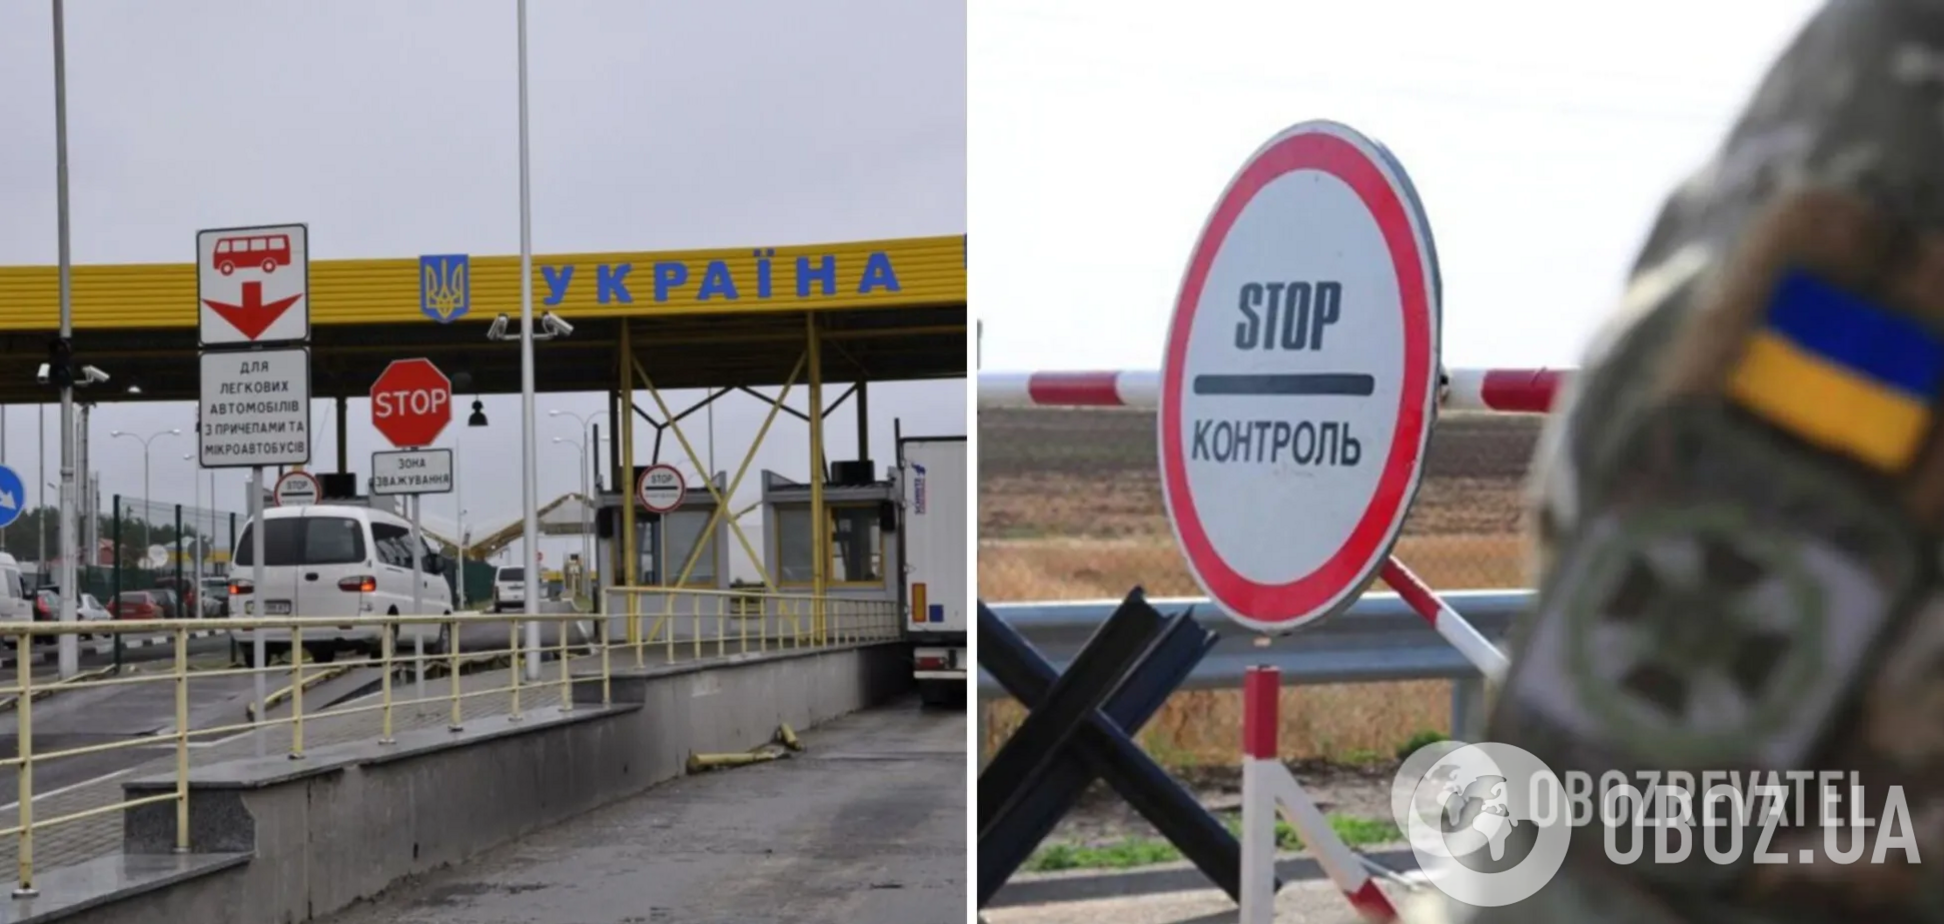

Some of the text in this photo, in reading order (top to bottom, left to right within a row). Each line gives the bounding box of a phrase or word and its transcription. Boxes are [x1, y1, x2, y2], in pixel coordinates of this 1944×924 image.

[540, 248, 900, 305] УКРАЇНА
[1235, 281, 1342, 351] STOP
[240, 361, 269, 374] ДЛЯ
[220, 381, 289, 395] ЛЕГКОВИХ
[210, 400, 299, 415] АВТОМОБІЛІВ
[375, 388, 447, 418] STOP
[205, 421, 304, 436] З ПРИЧЕПАМИ ТА
[204, 441, 304, 456] МІКРОАВТОБУСІВ
[1192, 419, 1361, 466] КОНТРОЛЬ
[398, 458, 426, 470] ЗОНА
[286, 480, 308, 490] STOP
[375, 473, 449, 487] ЗВАЖУВАННЯ
